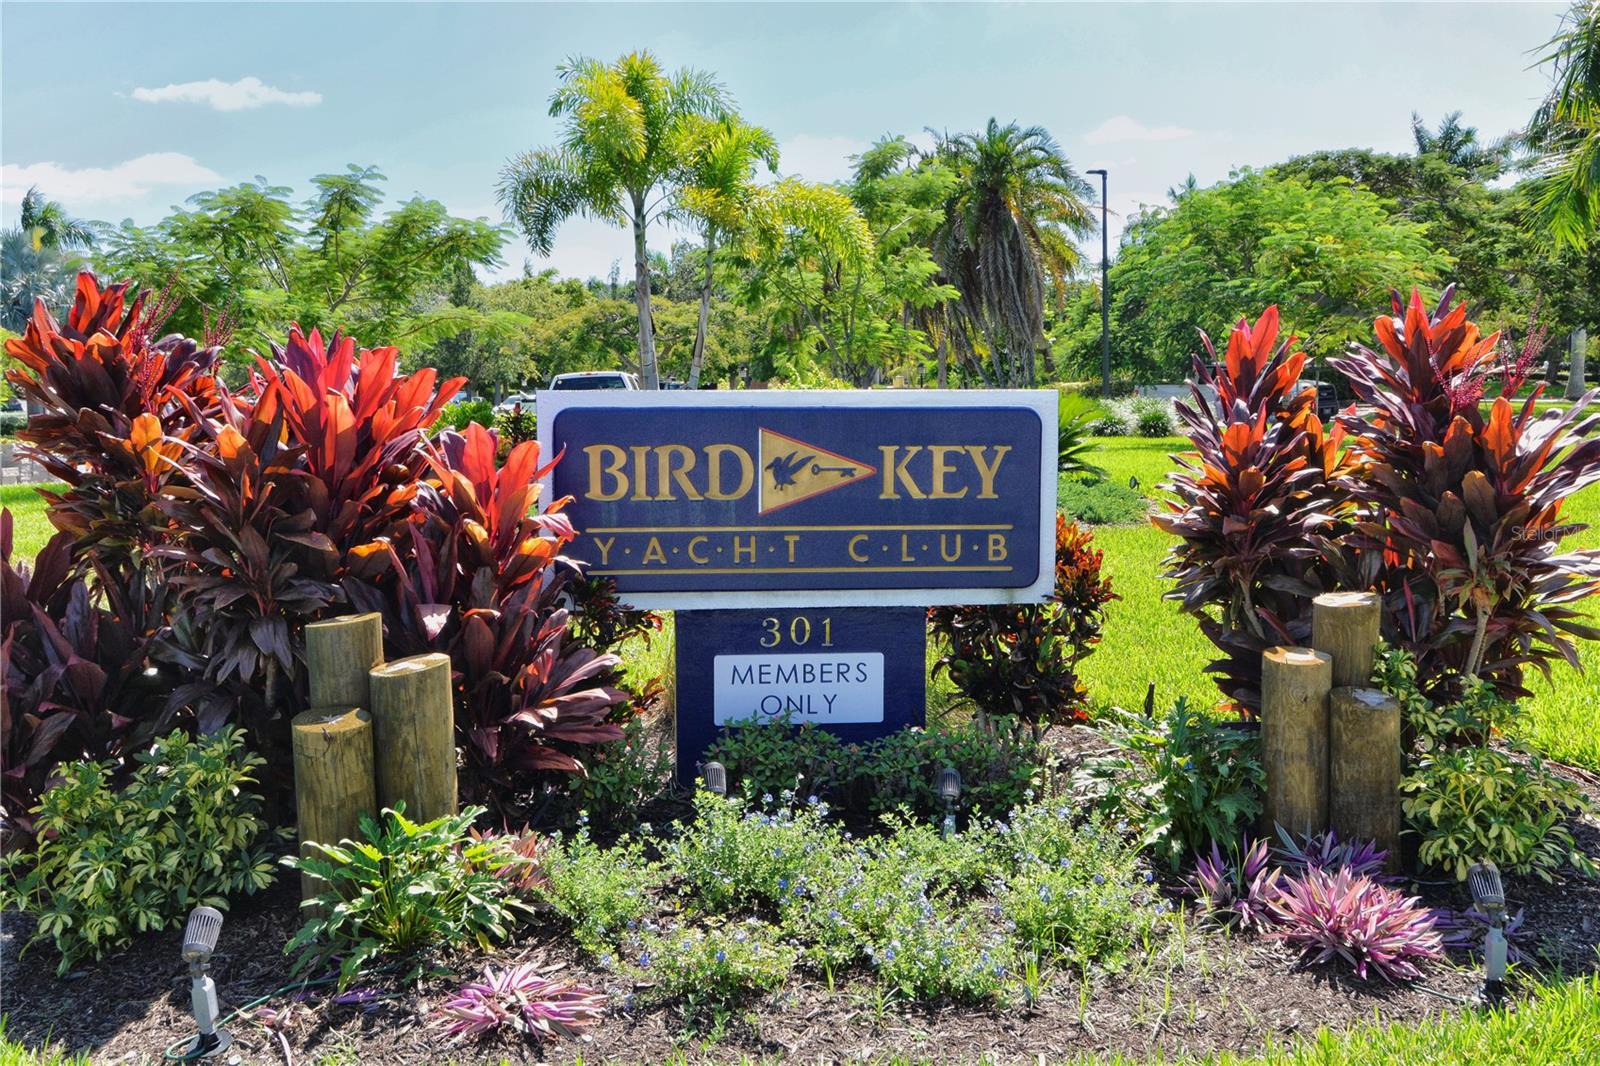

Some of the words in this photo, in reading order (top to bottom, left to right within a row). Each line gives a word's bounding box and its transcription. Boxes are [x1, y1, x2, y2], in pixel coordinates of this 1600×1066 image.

[583, 444, 755, 501] BIRD
[878, 445, 1012, 500] KEY
[760, 617, 834, 647] 301
[731, 662, 868, 685] MEMBERS
[761, 694, 837, 716] ONLY
